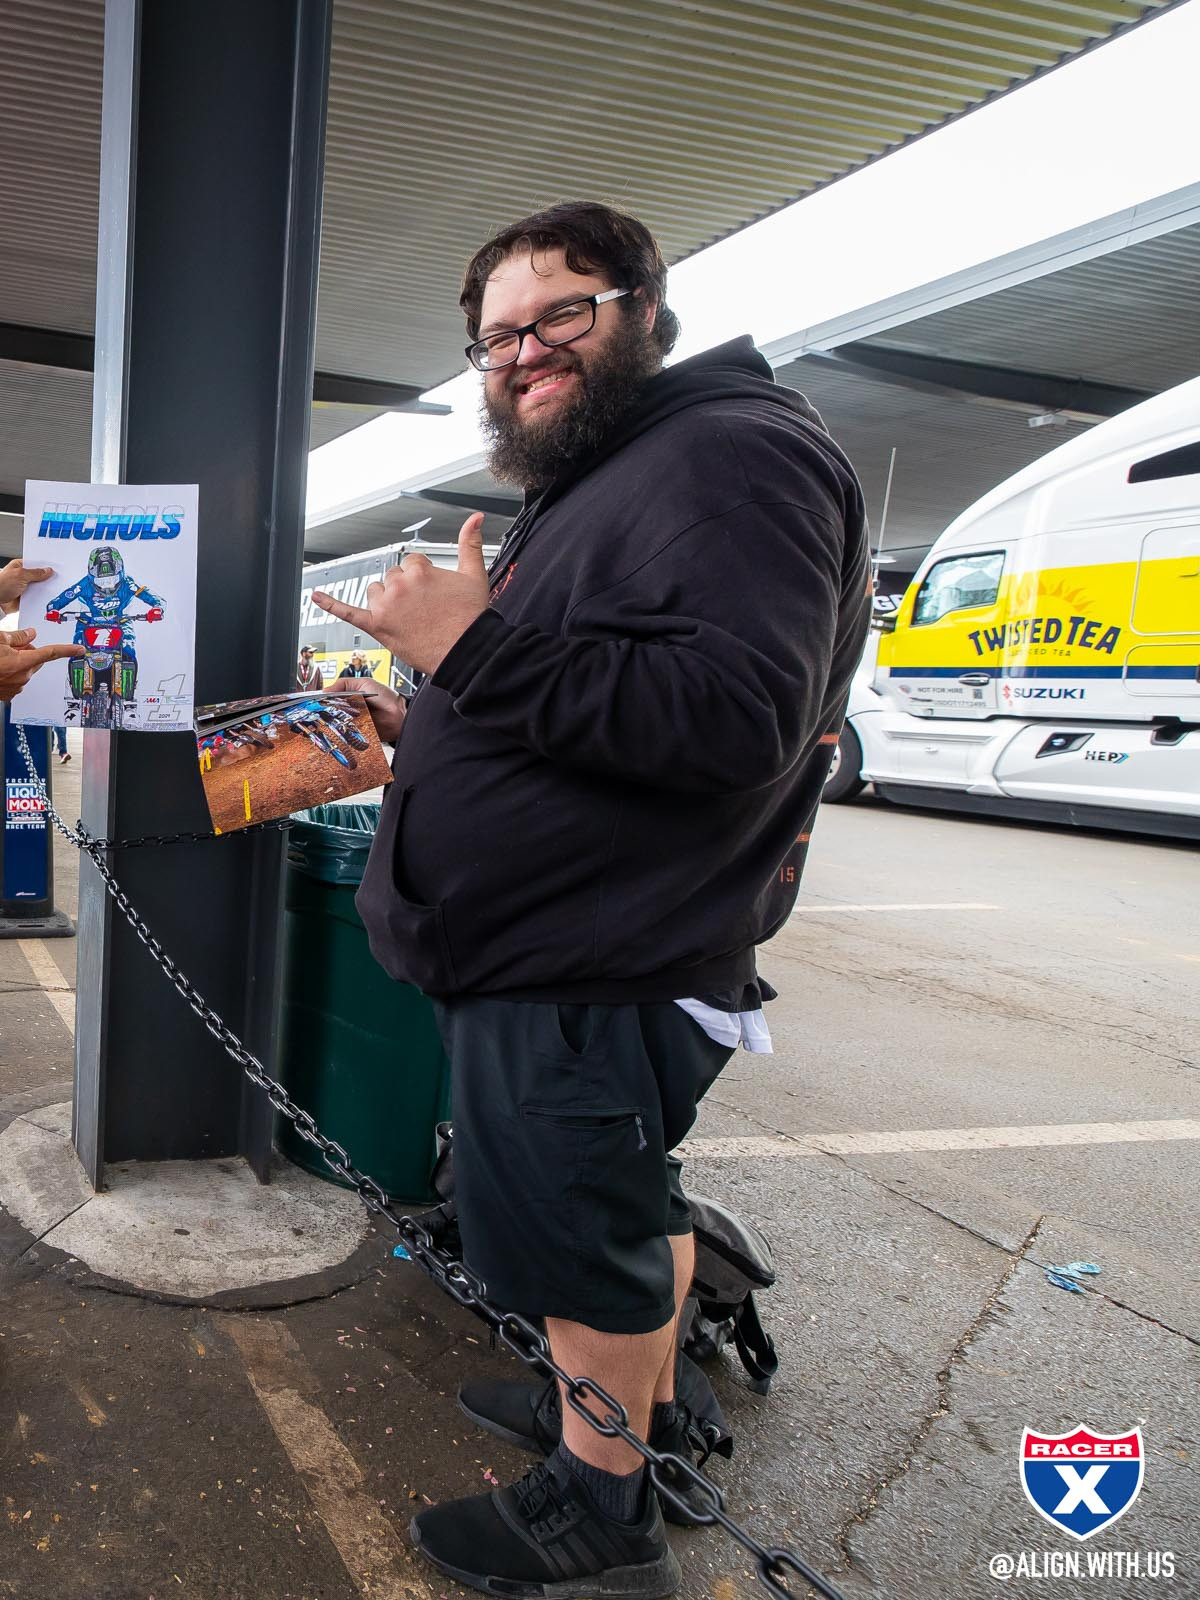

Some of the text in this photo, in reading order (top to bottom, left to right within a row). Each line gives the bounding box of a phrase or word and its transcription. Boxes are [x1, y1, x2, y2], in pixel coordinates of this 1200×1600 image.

[38, 502, 185, 540] NICHOLS
[968, 616, 1121, 656] TWISTED TEA
[1014, 688, 1086, 699] SUZUKI
[1085, 750, 1118, 762] HEP
[9, 787, 44, 799] LIQU
[9, 799, 45, 811] MOLY
